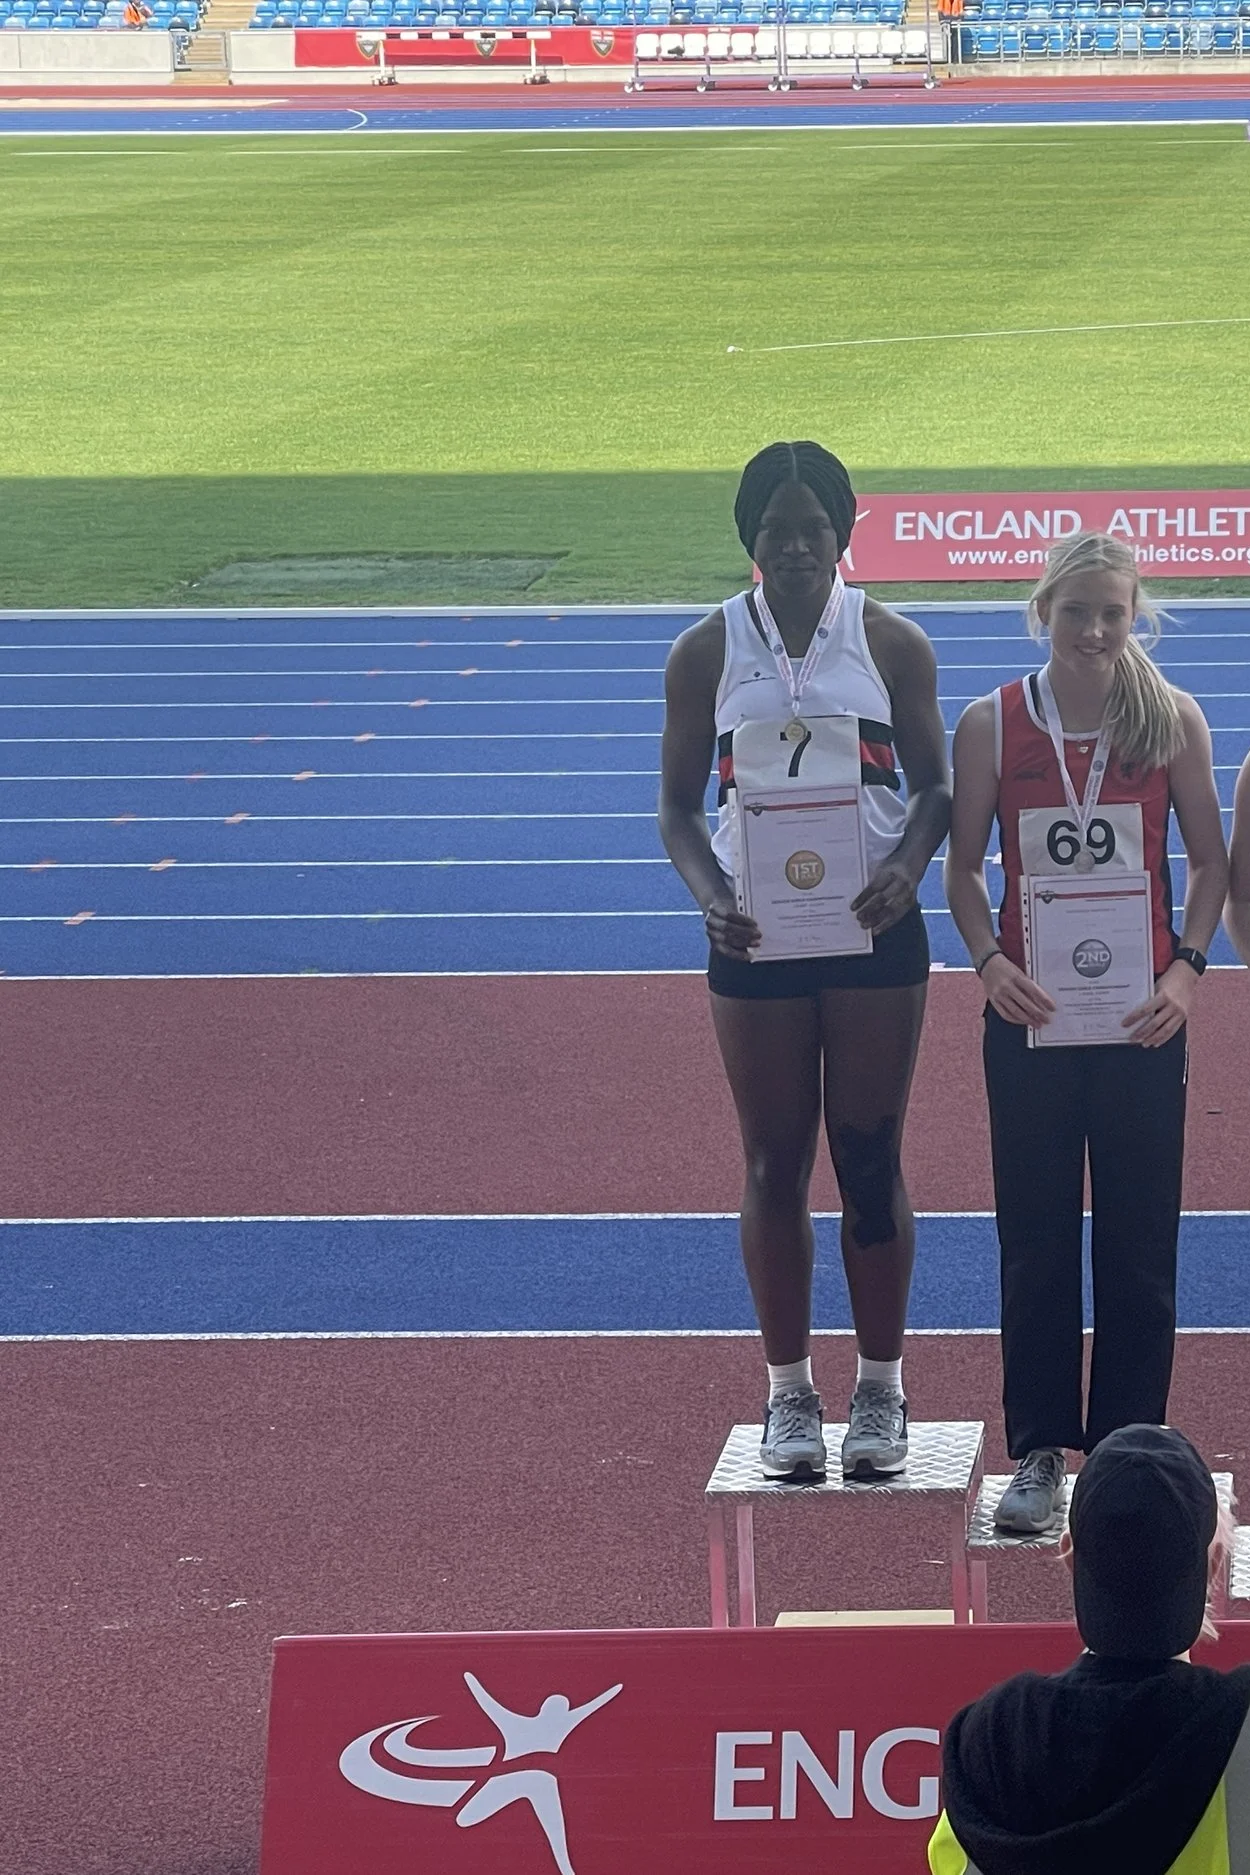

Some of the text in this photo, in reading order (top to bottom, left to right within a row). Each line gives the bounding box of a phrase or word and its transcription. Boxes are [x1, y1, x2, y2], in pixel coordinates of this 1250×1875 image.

[895, 509, 1082, 541] ENGLAND
[780, 730, 812, 778] 7
[1046, 817, 1116, 867] 69
[791, 861, 819, 880] 1ST
[1075, 950, 1110, 968] 2ND
